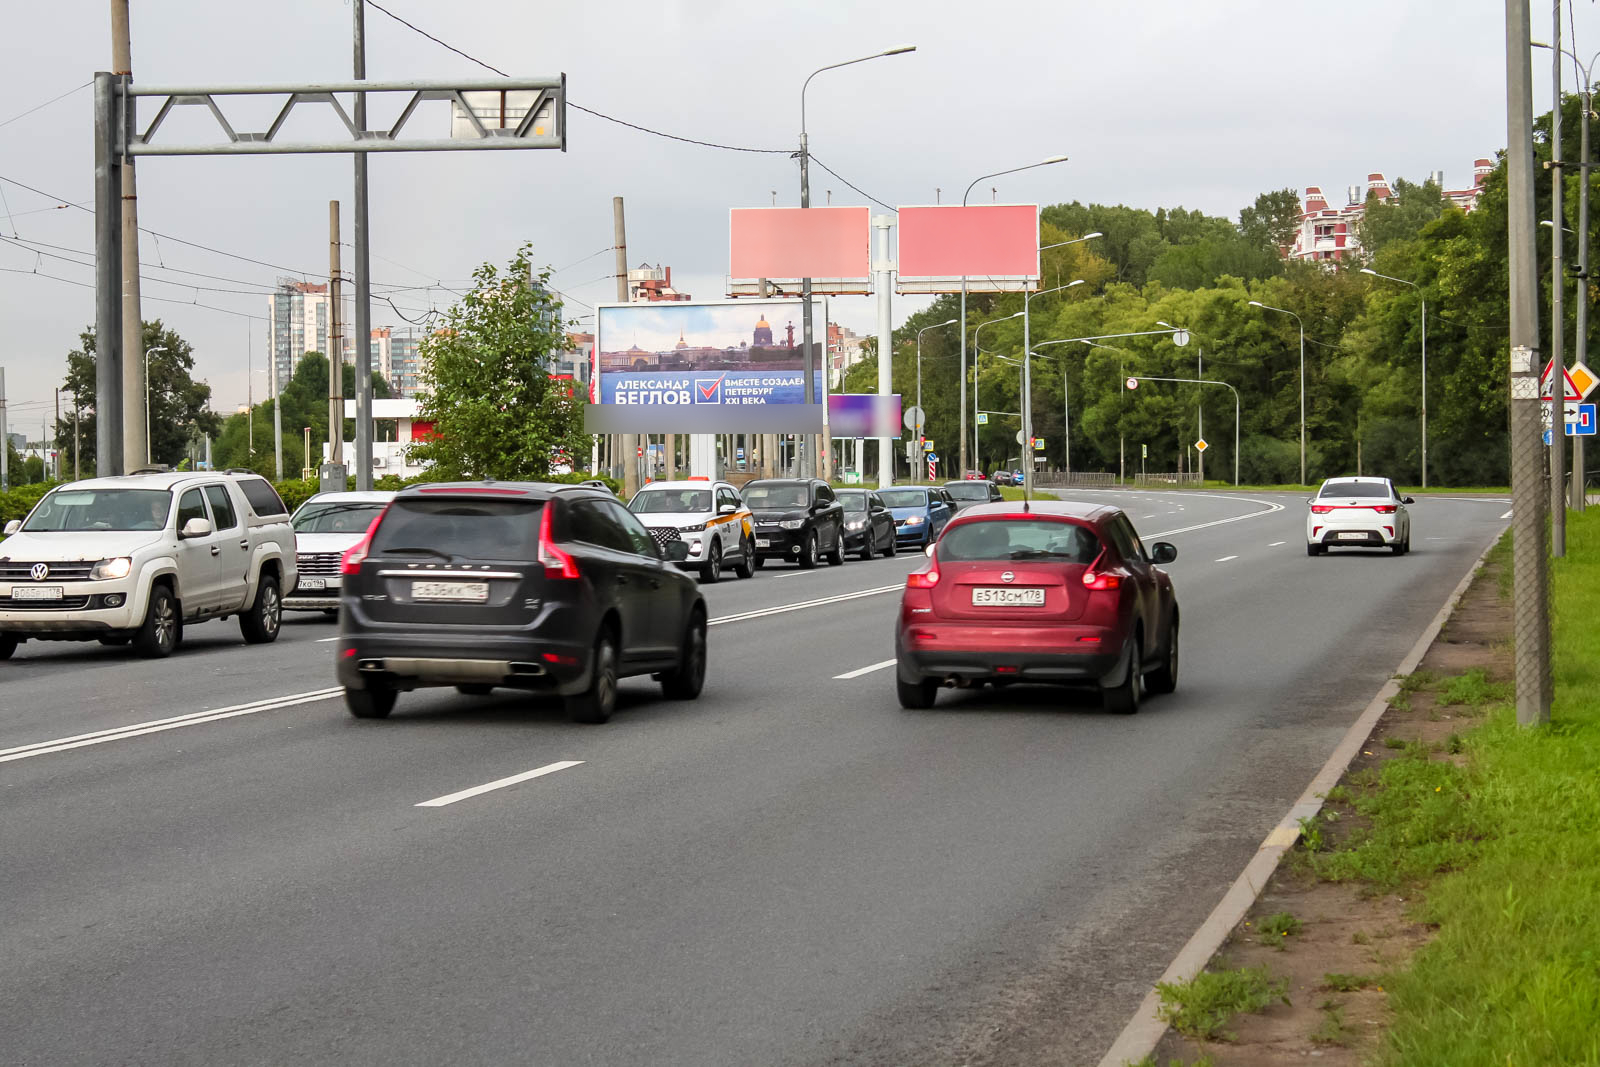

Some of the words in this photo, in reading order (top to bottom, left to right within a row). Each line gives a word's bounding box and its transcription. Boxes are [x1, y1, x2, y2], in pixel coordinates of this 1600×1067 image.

[615, 380, 690, 390] АЛЕКСАНДР
[724, 378, 760, 387] ВМЕСТЕ
[724, 387, 774, 396] ПЕТЕРБУРГ
[615, 390, 691, 405] БЕГЛОВ
[742, 397, 767, 405] ВЕКА
